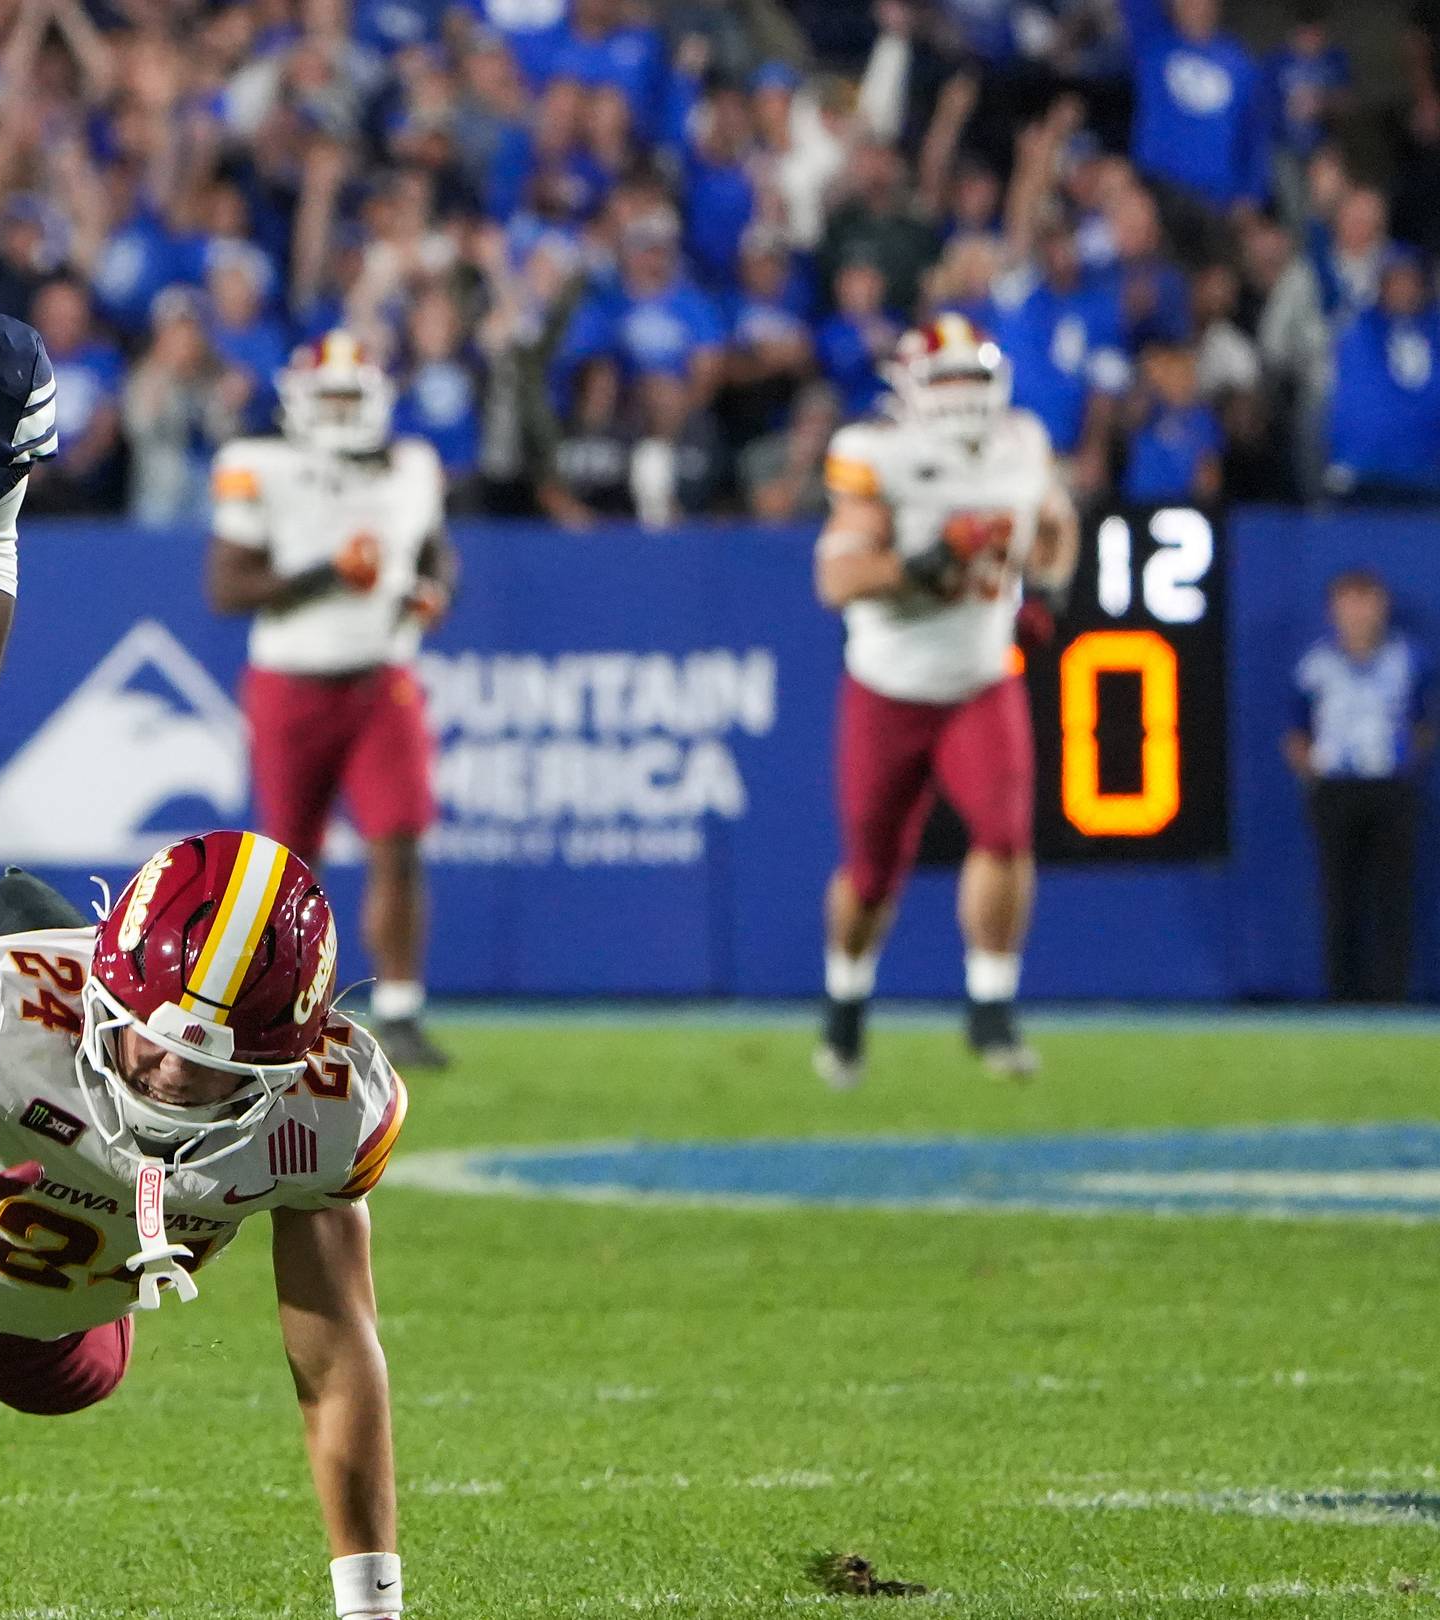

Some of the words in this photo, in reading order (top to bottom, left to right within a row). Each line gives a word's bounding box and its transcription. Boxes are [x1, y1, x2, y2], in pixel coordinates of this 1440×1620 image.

[1097, 507, 1214, 624] 12
[418, 651, 777, 735] OUNTAIN
[1003, 630, 1182, 837] 0
[433, 741, 747, 819] MERICA
[5, 948, 86, 1037] 24
[34, 1178, 118, 1215] IOWA
[143, 1172, 158, 1230] BATTLE
